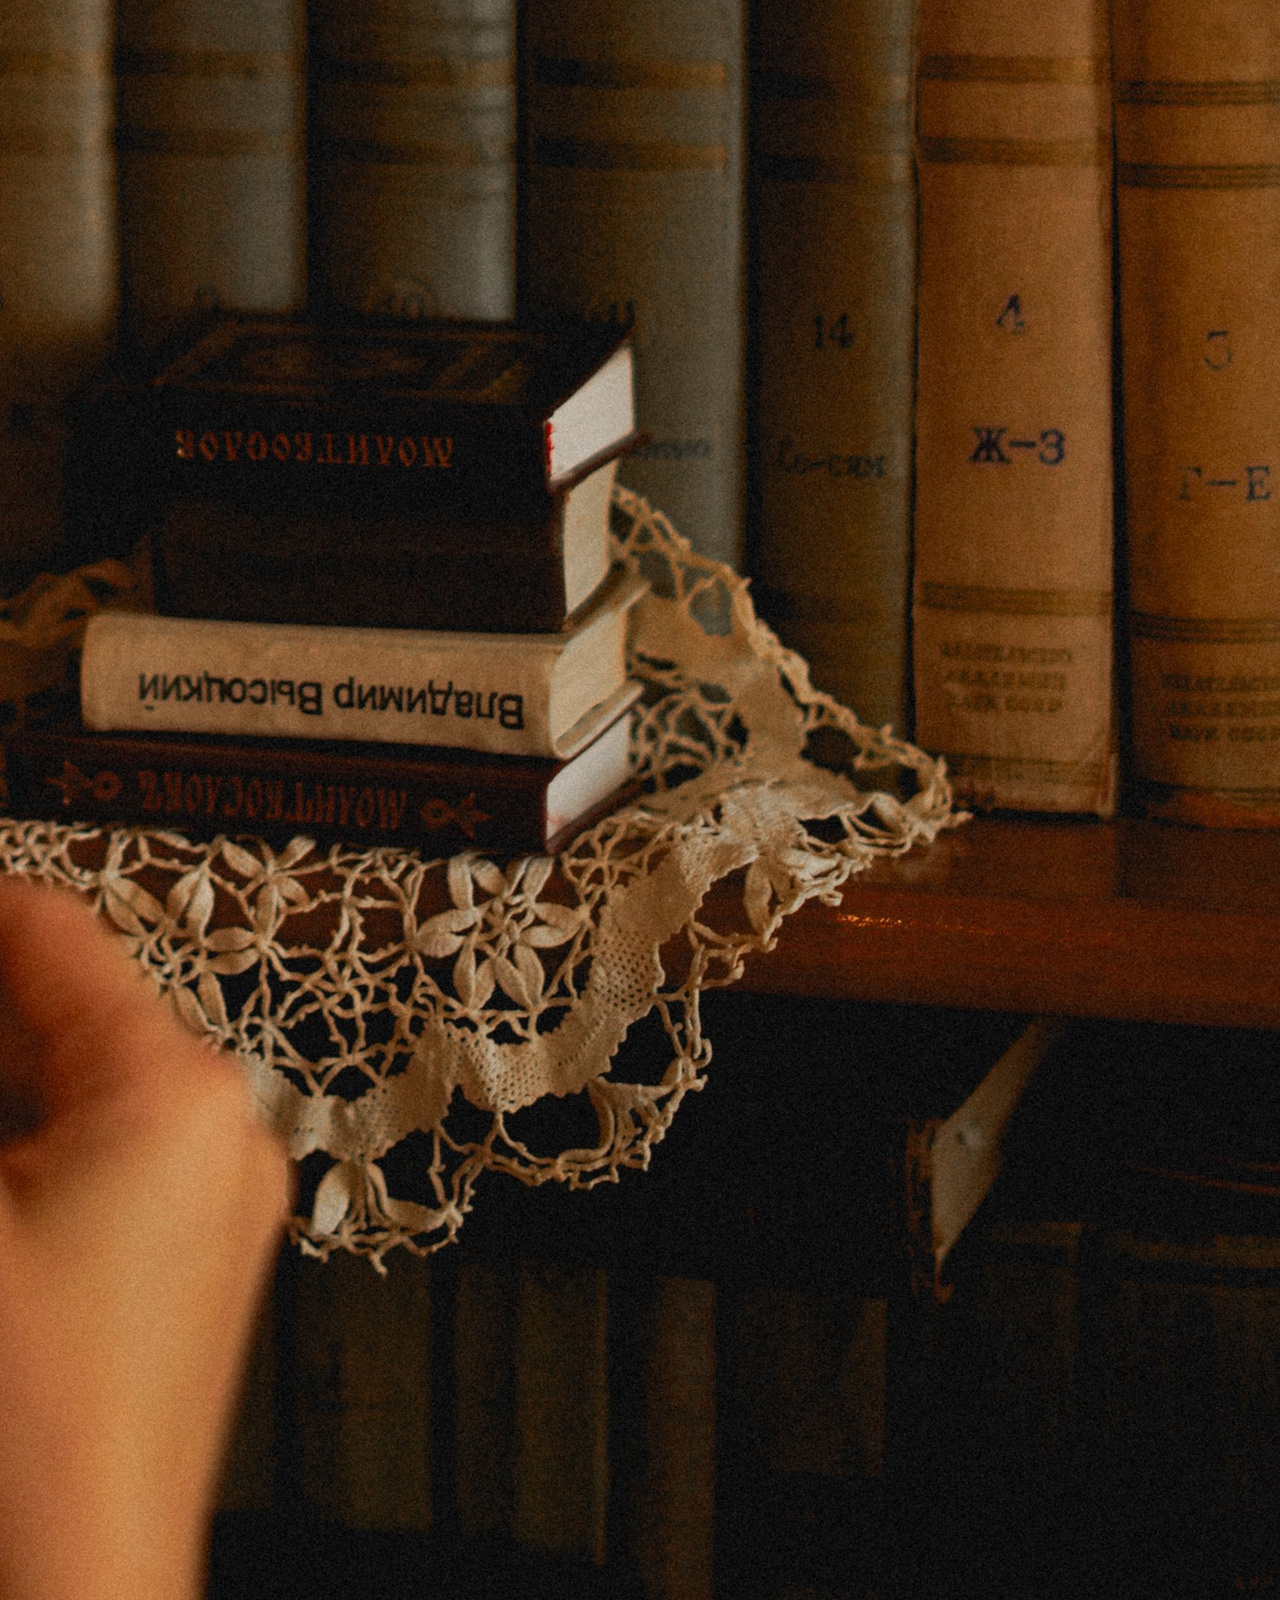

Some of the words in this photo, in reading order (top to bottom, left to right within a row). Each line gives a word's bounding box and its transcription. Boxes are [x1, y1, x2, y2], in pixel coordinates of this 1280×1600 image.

[812, 311, 856, 350] 14
[138, 670, 324, 716] Высоцкий
[333, 677, 525, 730] Владимир
